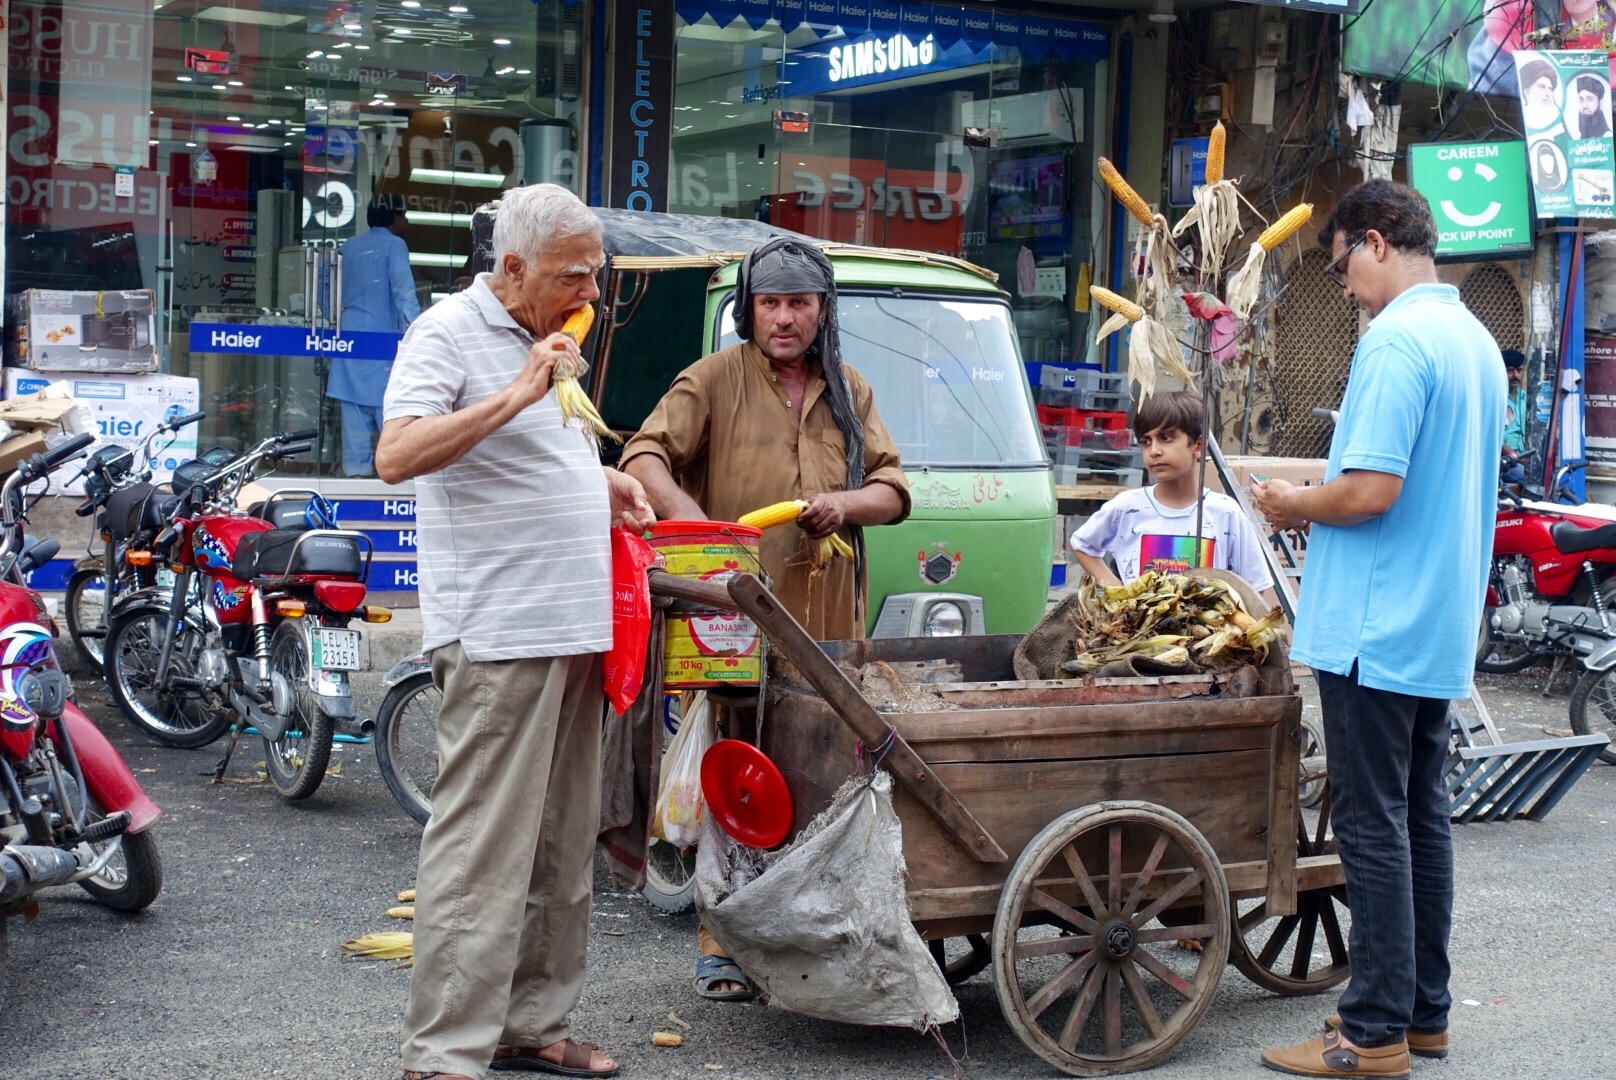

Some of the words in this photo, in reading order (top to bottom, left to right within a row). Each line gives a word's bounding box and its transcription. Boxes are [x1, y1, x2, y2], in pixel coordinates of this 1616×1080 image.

[809, 3, 835, 13] Haier
[841, 6, 866, 16] Haier
[873, 8, 898, 20] Haier
[904, 12, 929, 23] Haier
[935, 15, 959, 27] Haier
[965, 18, 989, 29] Haier
[995, 21, 1019, 33] Haier
[1025, 25, 1049, 36] Haier
[1054, 28, 1078, 39] Haier
[1083, 30, 1106, 41] Haier
[829, 34, 935, 82] SAMSUNG
[1437, 146, 1499, 160] CAREEM
[232, 221, 253, 229] OFFICE
[1438, 232, 1459, 242] ICK
[1461, 231, 1476, 241] UP
[1478, 228, 1515, 240] POINT
[211, 331, 261, 348] Haier
[306, 335, 354, 352] Haier
[973, 366, 1004, 382] Haier
[914, 499, 939, 509] NEW
[943, 499, 970, 510] ASIA
[315, 541, 353, 550] HONDA
[1153, 558, 1189, 571] TEAM
[322, 631, 341, 648] LEL
[344, 636, 355, 648] 15
[323, 650, 356, 667] 2315A
[679, 660, 689, 670] 10
[691, 660, 703, 671] kg
